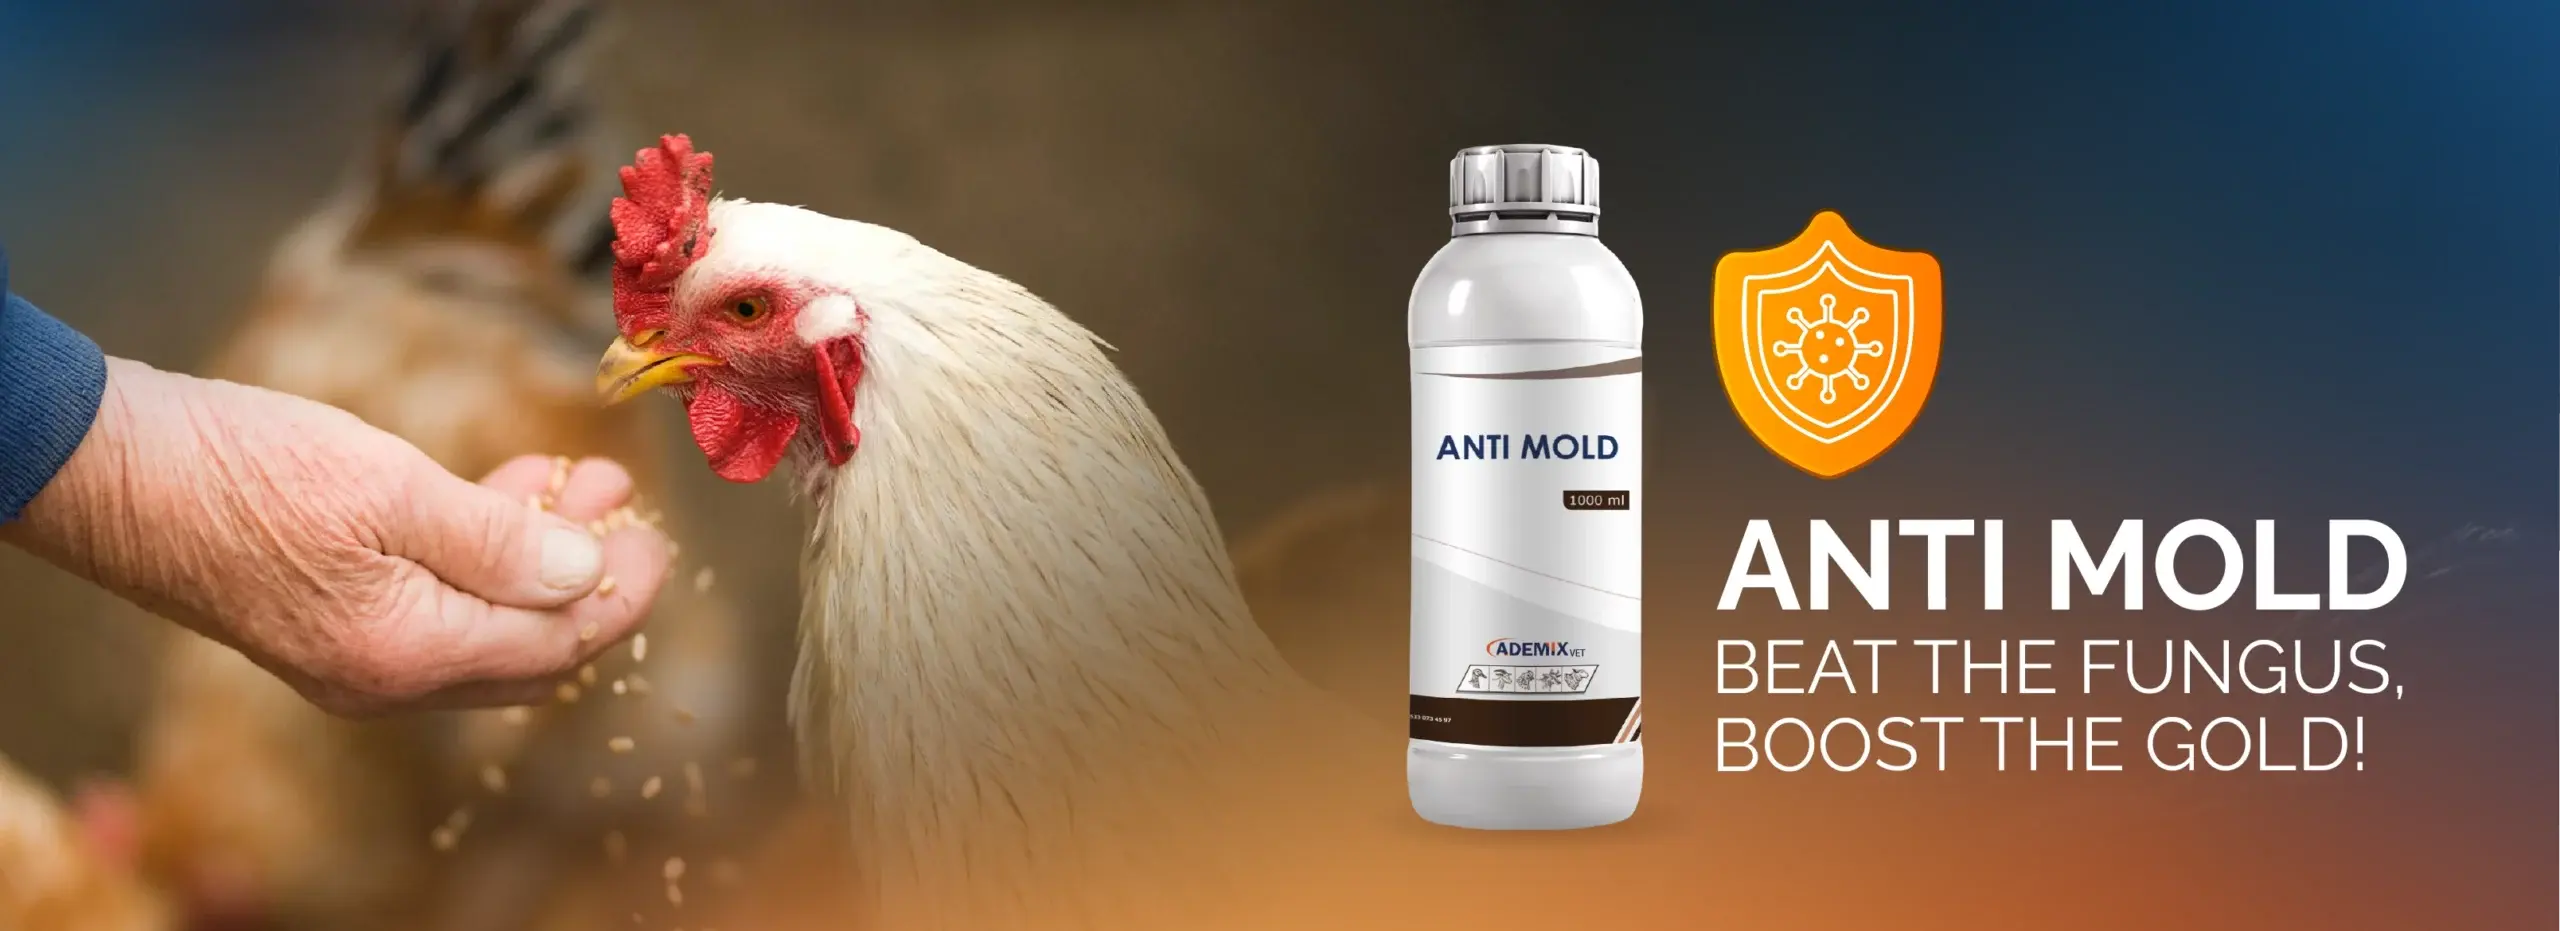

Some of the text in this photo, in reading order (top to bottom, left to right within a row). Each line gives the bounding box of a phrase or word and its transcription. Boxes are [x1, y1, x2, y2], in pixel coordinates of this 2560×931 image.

[1436, 433, 1619, 460] ANTI MOLD
[1570, 494, 1626, 507] 1000 ml
[1496, 641, 1586, 657] ADEMIX VET
